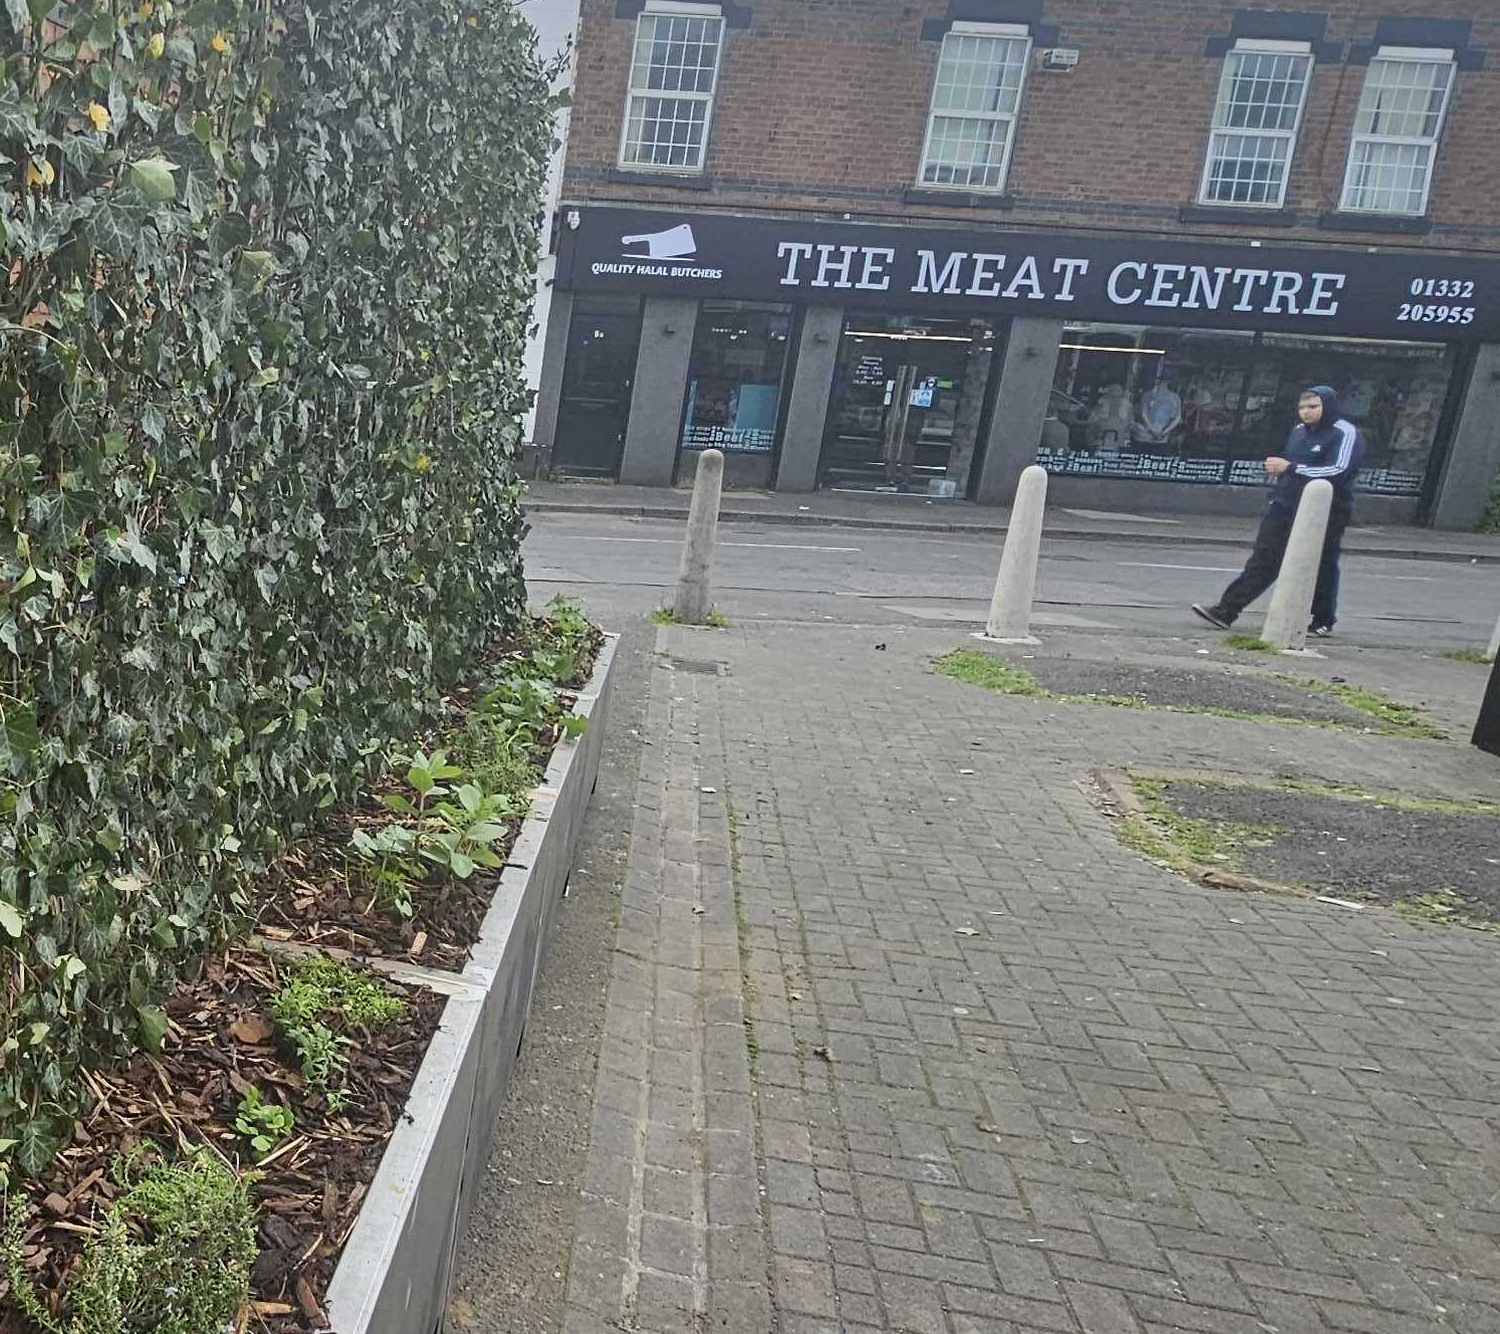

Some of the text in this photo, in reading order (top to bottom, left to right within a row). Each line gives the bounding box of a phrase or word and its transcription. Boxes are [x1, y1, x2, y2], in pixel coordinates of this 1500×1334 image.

[591, 263, 723, 279] QUALITY HALAL BUTCHERS
[777, 242, 1346, 316] THE MEAT CENTRE
[1411, 278, 1474, 298] 01332
[1397, 303, 1475, 324] 205955
